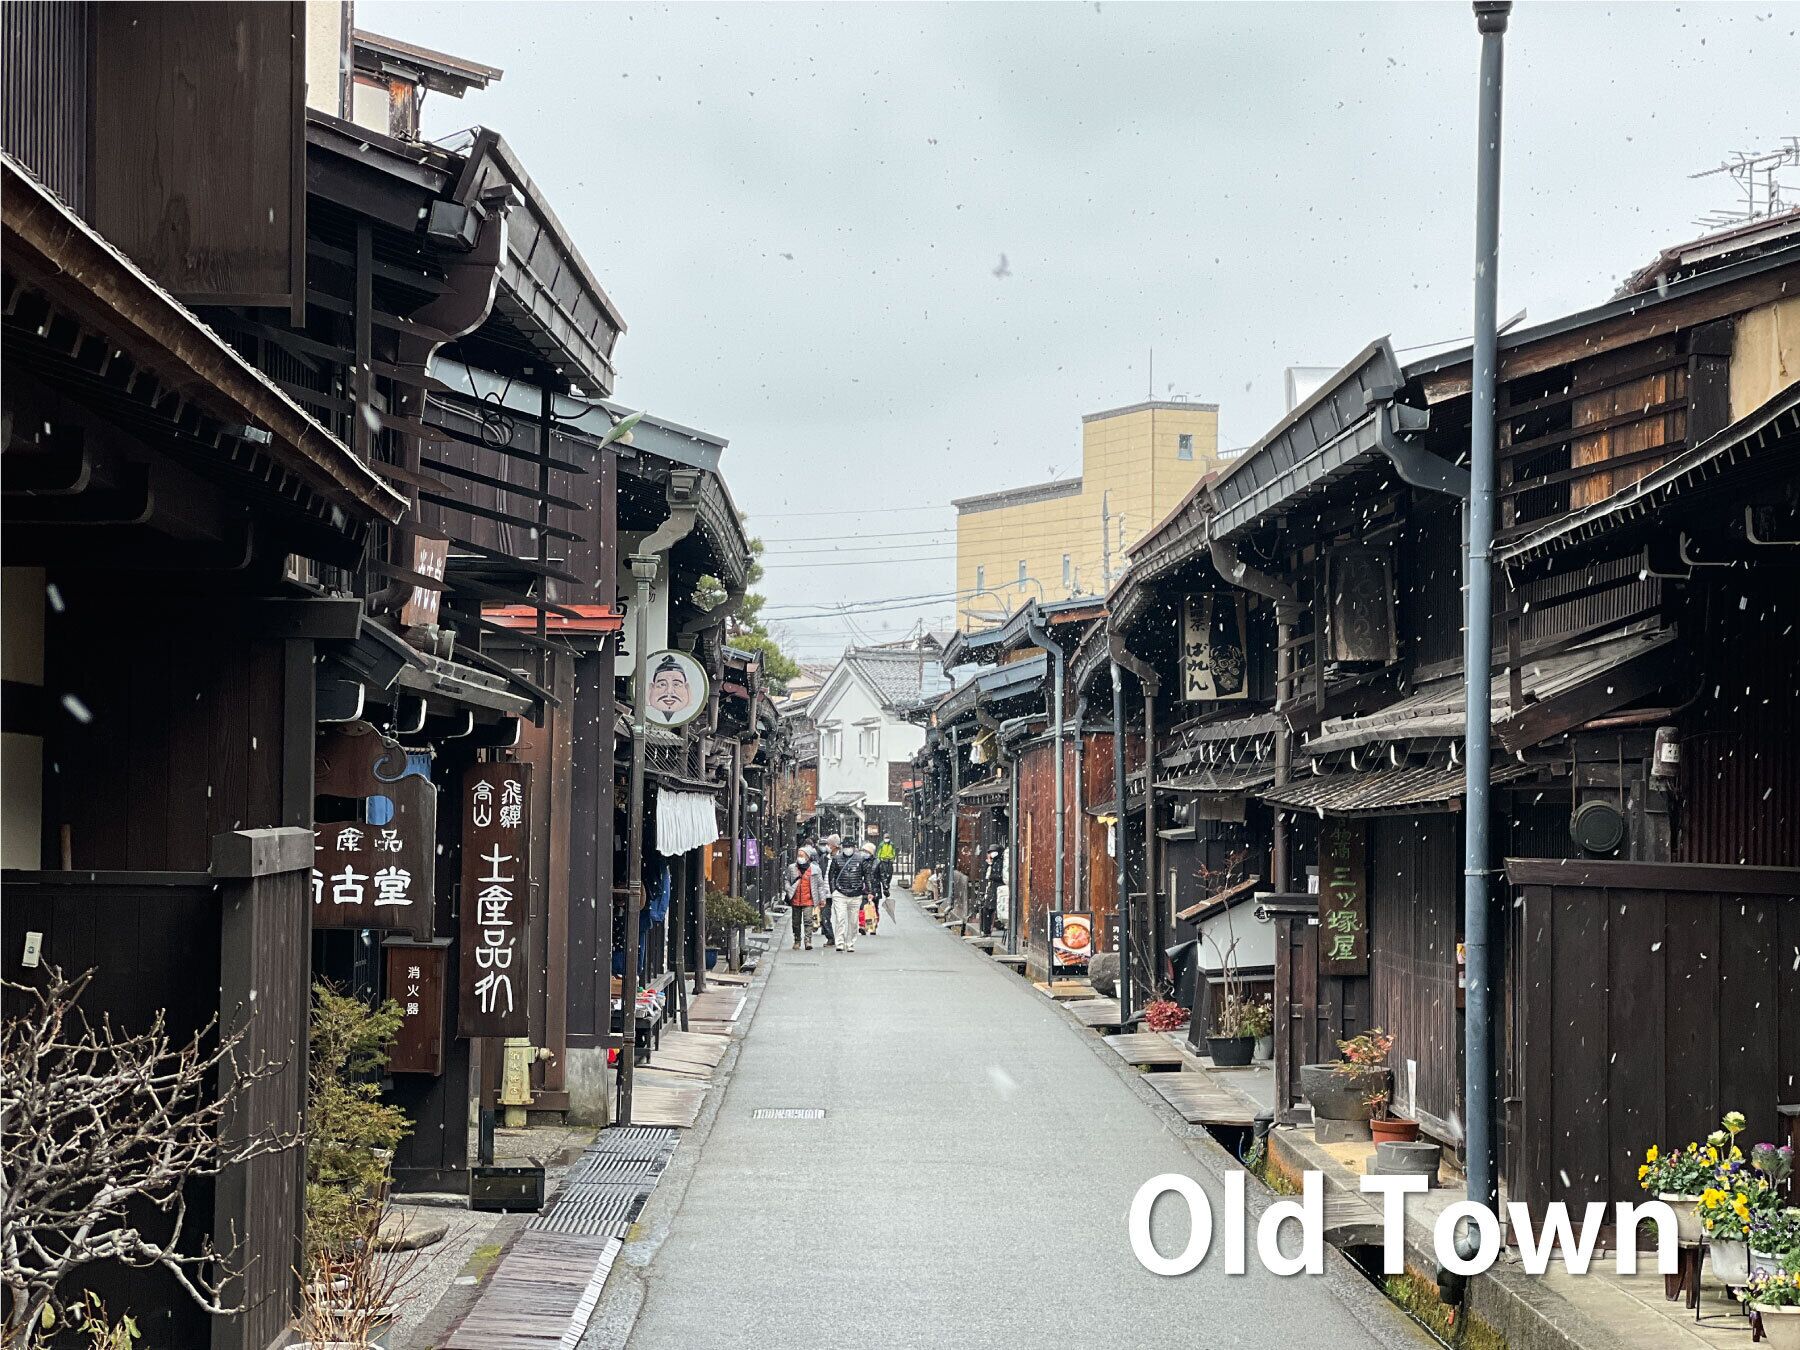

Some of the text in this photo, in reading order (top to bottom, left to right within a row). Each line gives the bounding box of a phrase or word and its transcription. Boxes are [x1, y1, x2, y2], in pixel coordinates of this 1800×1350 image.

[1185, 642, 1209, 692] ばれん
[472, 780, 494, 827] 高山
[1328, 867, 1359, 961] 三ツ塚屋
[407, 966, 420, 1015] 消火器
